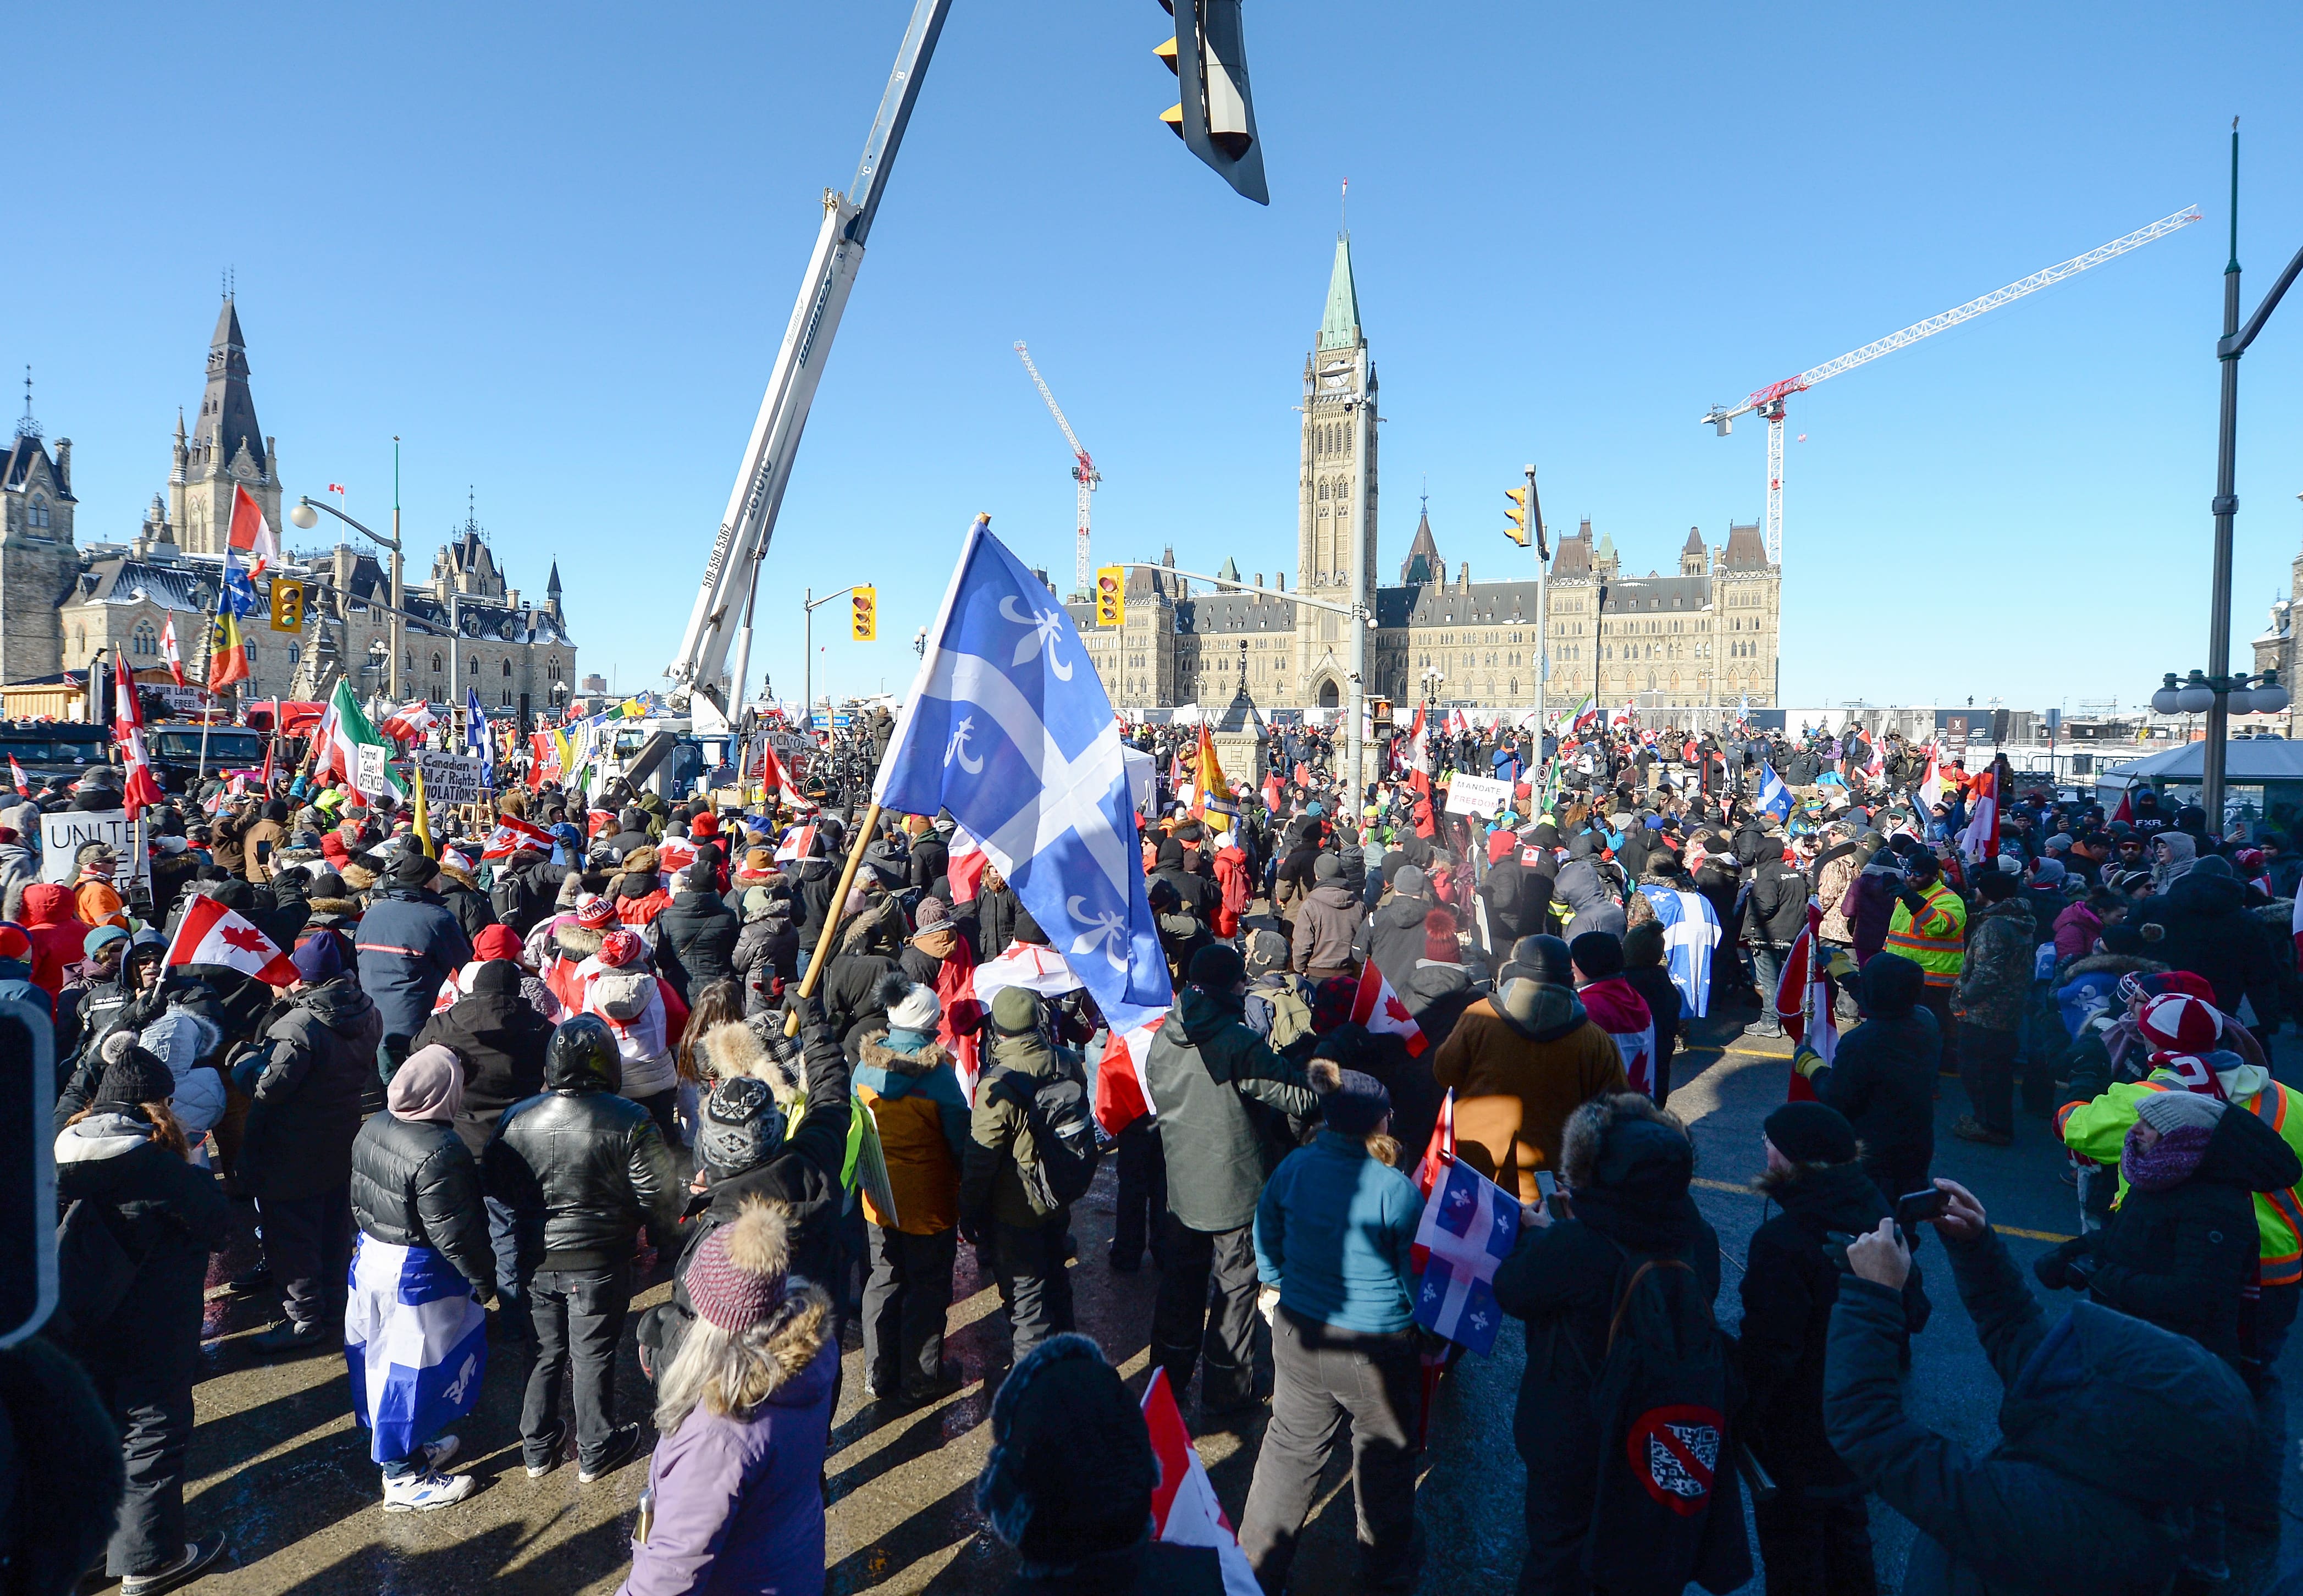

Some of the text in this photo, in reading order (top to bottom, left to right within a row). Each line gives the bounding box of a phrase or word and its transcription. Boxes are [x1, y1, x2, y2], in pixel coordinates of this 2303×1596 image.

[703, 523, 732, 588] 519-550-5362
[174, 699, 195, 708] FREE!
[361, 745, 378, 761] Criminal
[363, 761, 374, 774] Code
[423, 754, 470, 771] Canadian
[359, 773, 383, 792] OFFENCES
[435, 770, 444, 783] of
[449, 771, 476, 789] Rights
[1457, 781, 1501, 795] MANDATE
[52, 820, 141, 848] UNITE
